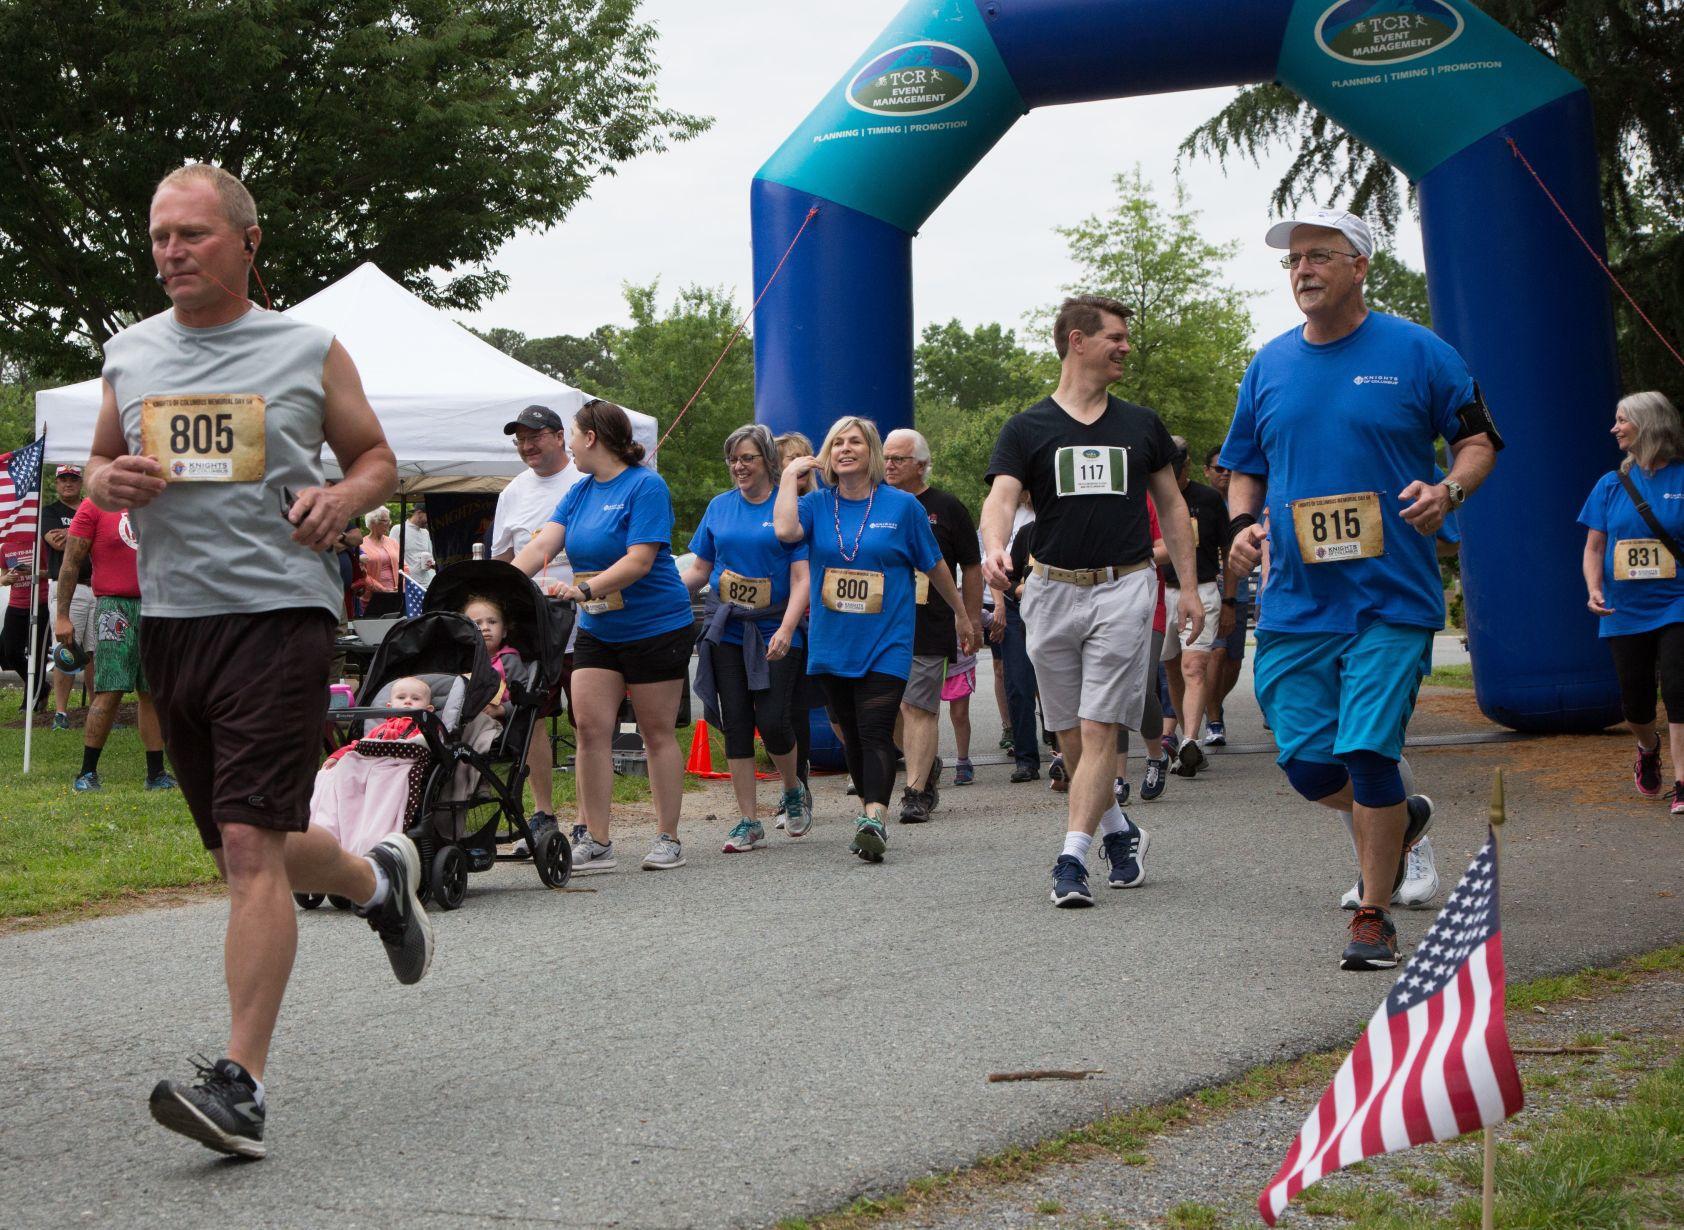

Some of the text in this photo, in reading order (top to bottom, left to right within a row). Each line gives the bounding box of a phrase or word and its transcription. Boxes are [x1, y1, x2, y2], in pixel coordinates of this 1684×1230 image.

[1370, 15, 1411, 33] TCR
[1373, 31, 1410, 44] EVENT
[1352, 38, 1432, 56] MANAGEMENT
[890, 69, 927, 86] TCR
[1332, 61, 1502, 88] PLANNING TIMING PROMOTION
[873, 93, 946, 107] MANAGEMENT
[892, 86, 925, 96] EVENT
[813, 120, 968, 143] PLANNING TIMING PROMOTION
[170, 413, 234, 454] 805
[1080, 464, 1104, 480] 117
[1311, 508, 1361, 542] 815
[1328, 544, 1358, 552] KNIGHTS
[1628, 547, 1659, 567] 831
[730, 581, 757, 604] 822
[836, 578, 869, 600] 800
